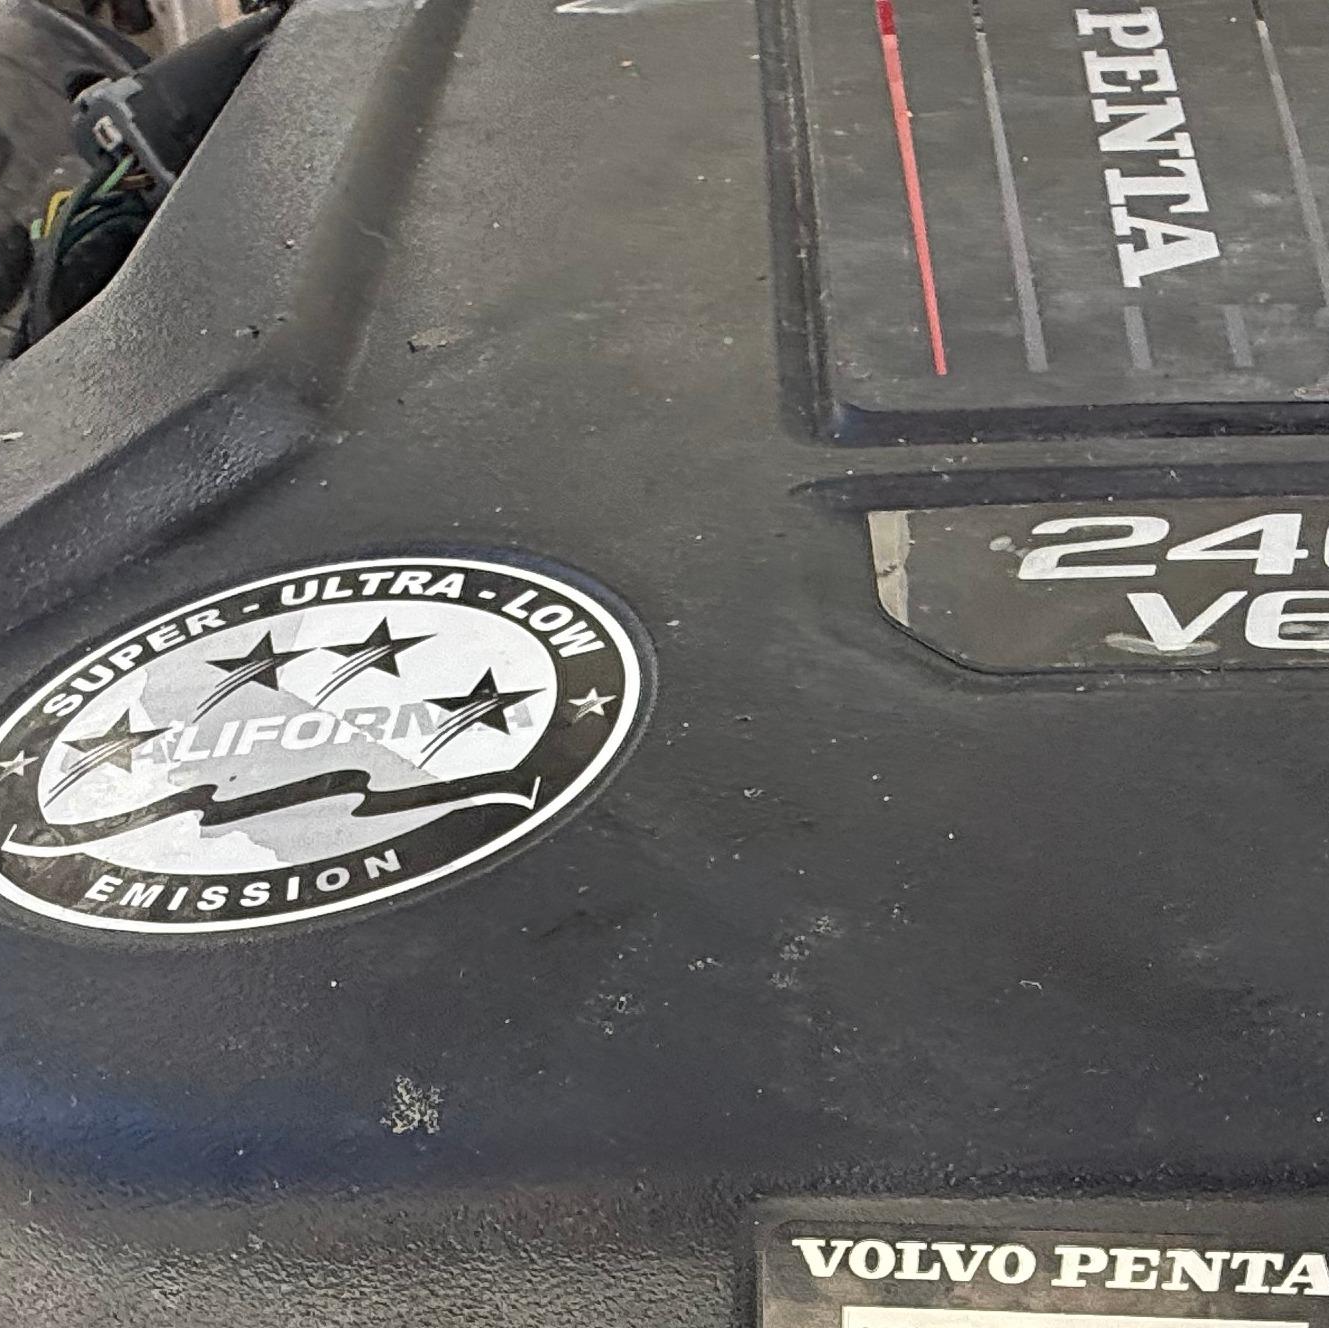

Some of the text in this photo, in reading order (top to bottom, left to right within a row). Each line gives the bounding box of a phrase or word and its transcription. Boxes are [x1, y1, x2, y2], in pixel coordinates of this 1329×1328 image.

[1076, 6, 1221, 289] PENTA
[43, 606, 227, 718] SUPER
[280, 569, 464, 607] ULTRA
[494, 588, 608, 660] LOW
[84, 847, 404, 912] EMISSION
[791, 1237, 1037, 1285] VOLVO
